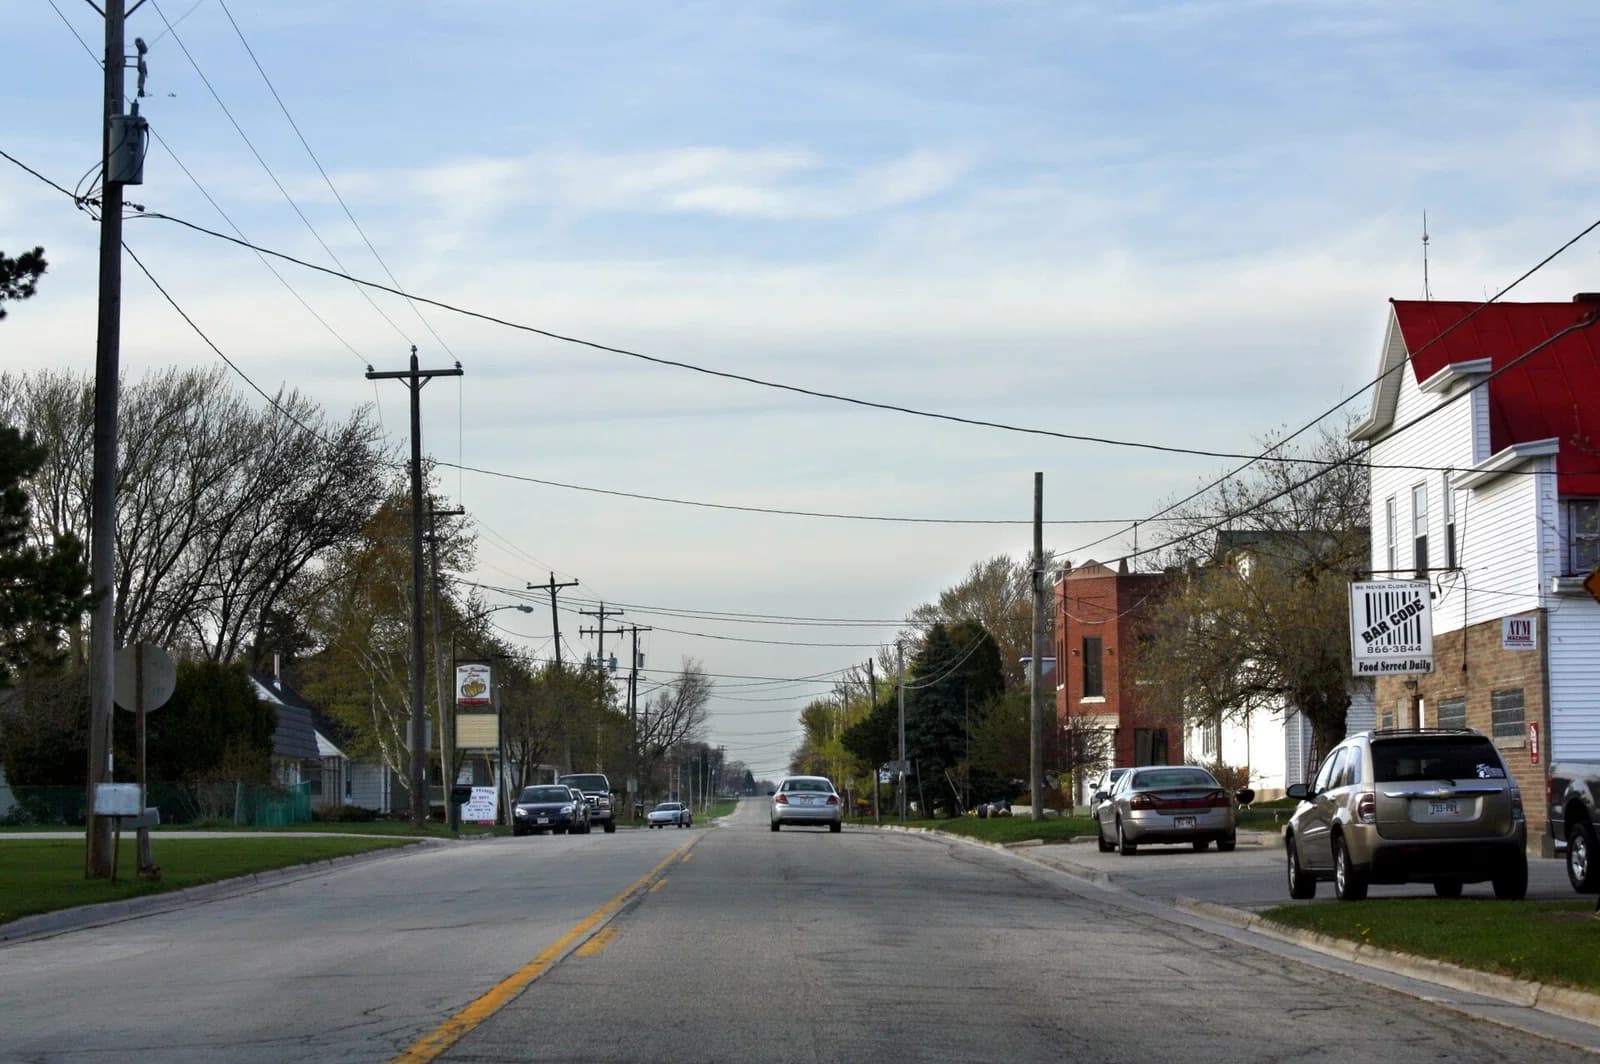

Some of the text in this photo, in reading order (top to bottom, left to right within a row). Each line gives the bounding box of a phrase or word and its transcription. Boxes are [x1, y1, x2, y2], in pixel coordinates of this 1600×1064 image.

[1361, 598, 1425, 644] BAR CODE
[1507, 620, 1530, 635] ATM
[1367, 645, 1422, 654] 866-3844
[1358, 659, 1431, 672] Food Served Daily
